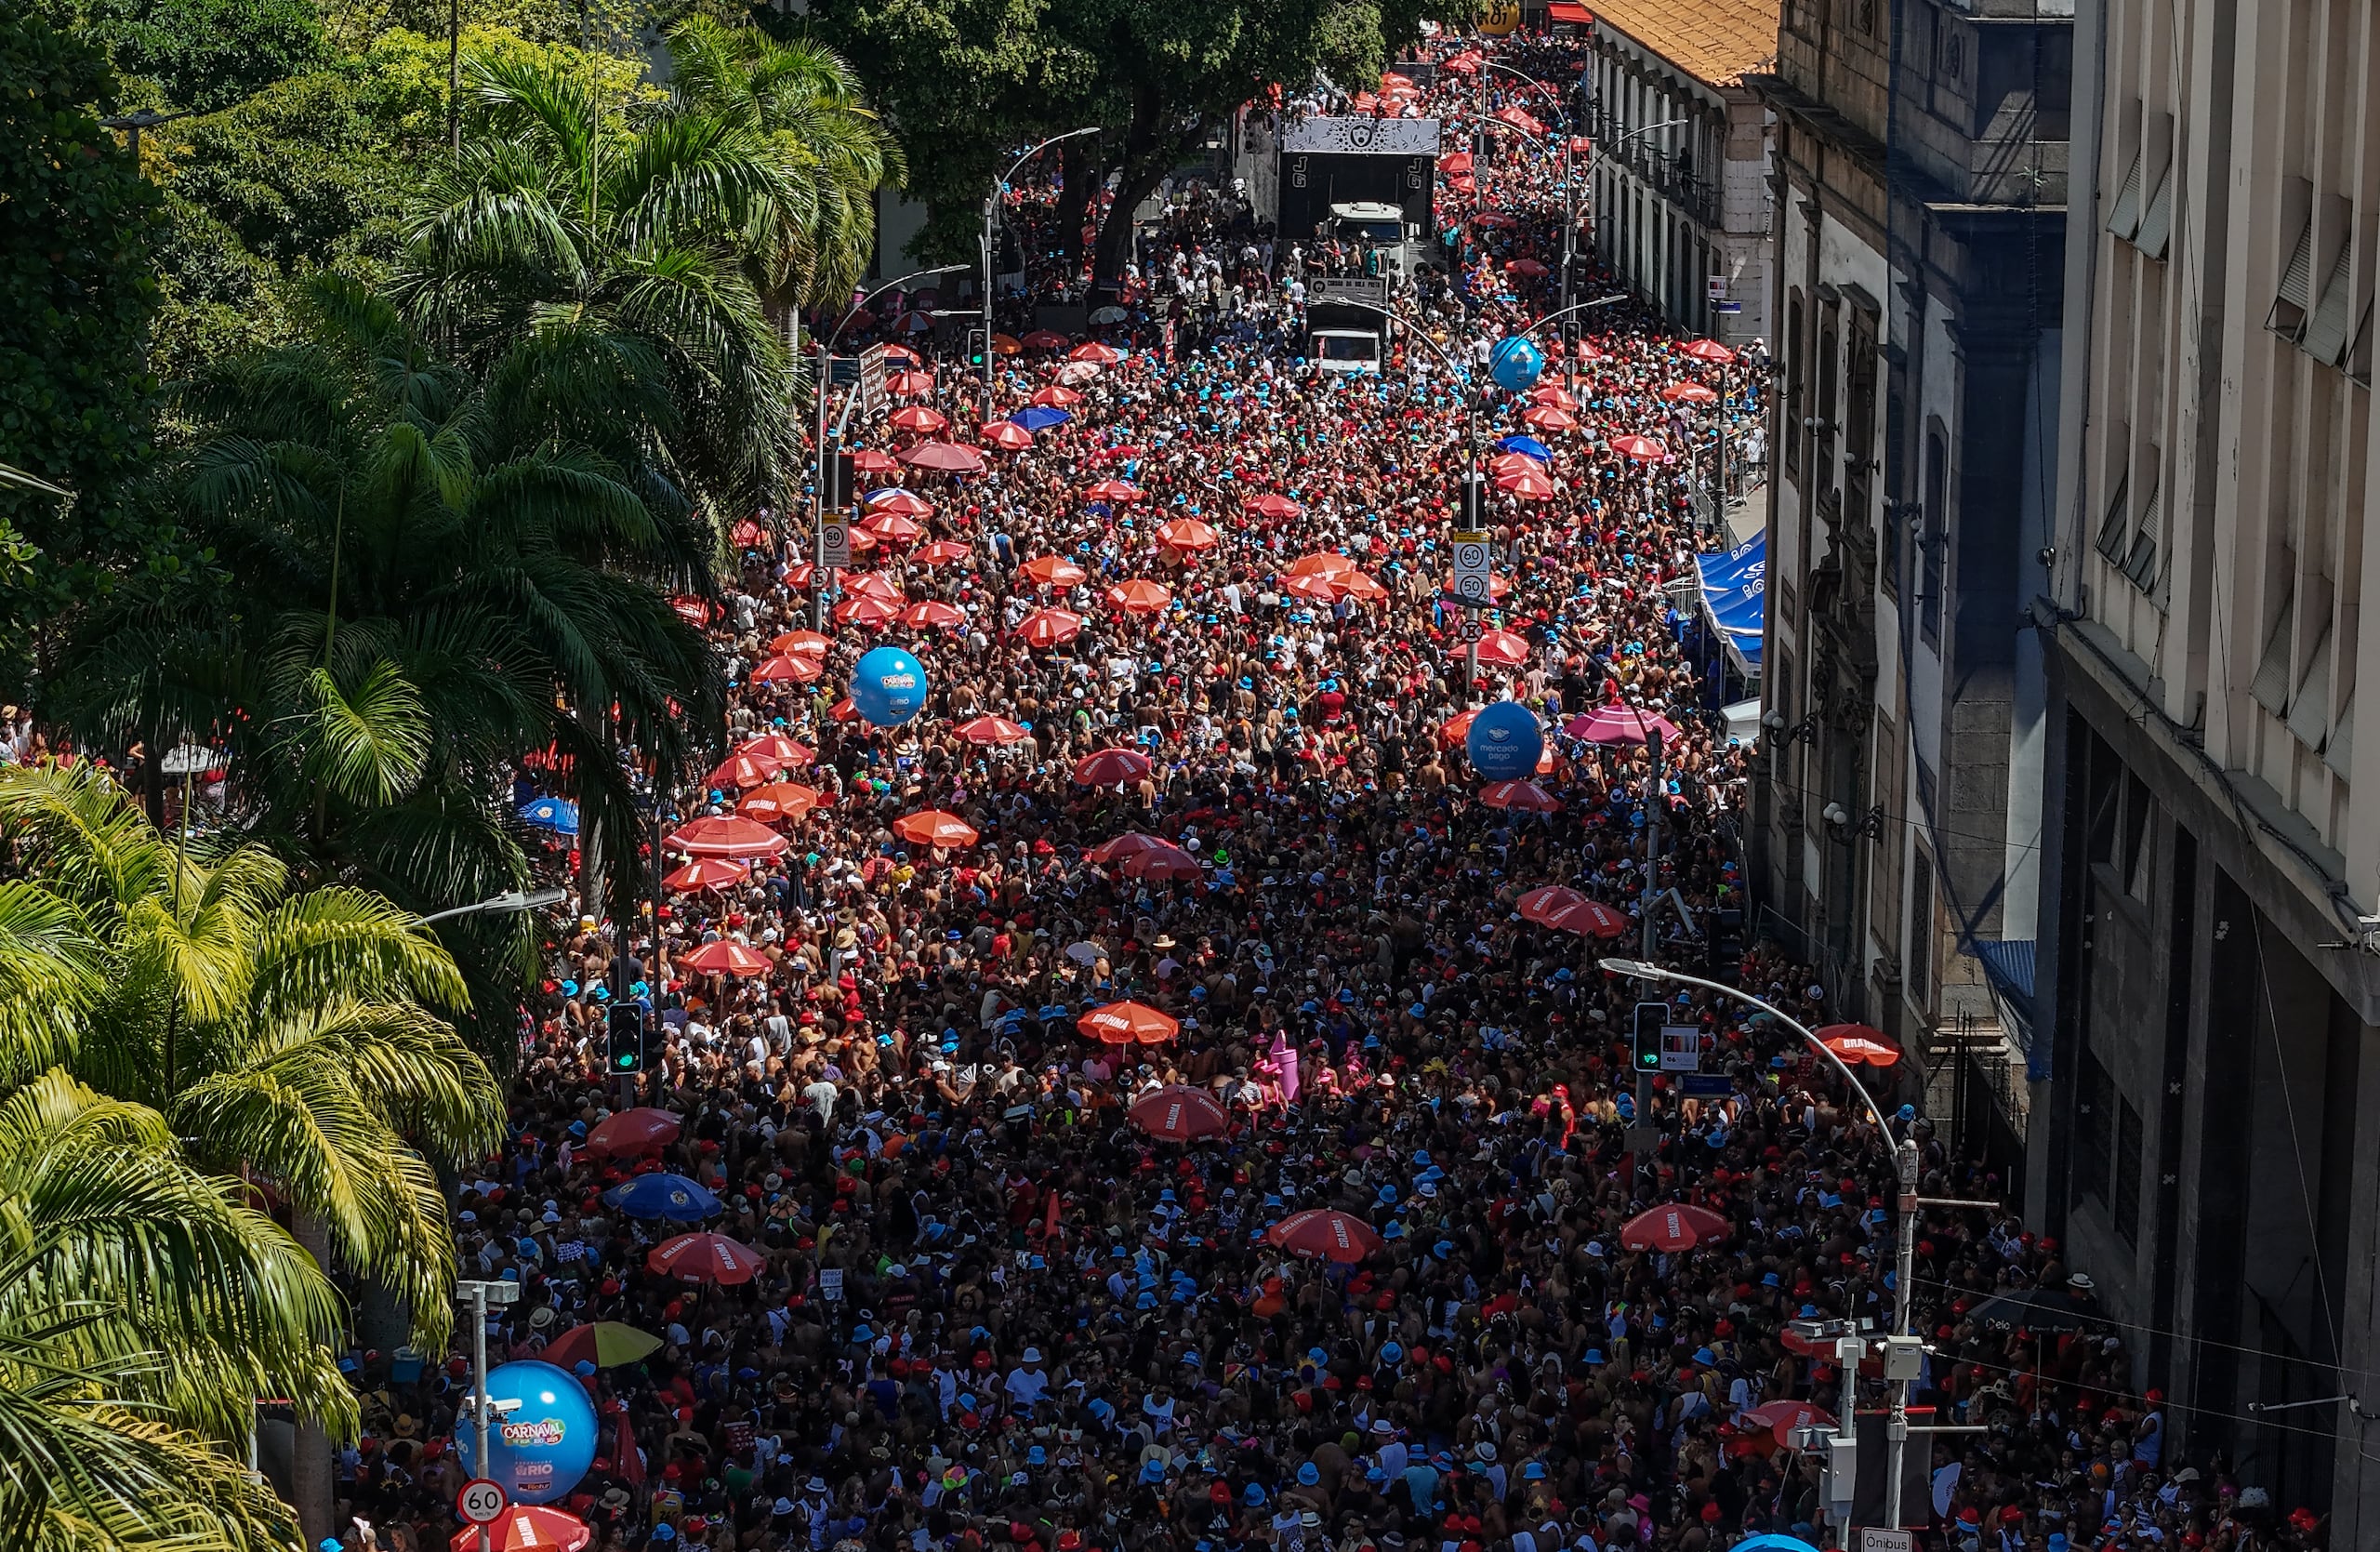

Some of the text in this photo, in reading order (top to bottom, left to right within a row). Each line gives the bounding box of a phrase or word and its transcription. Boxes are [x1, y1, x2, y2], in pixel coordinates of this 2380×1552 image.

[826, 532, 840, 541] 60
[1463, 550, 1479, 561] 60
[1464, 580, 1480, 591] 50
[793, 641, 826, 651] BRAHMA
[1480, 744, 1519, 752] mercado
[1488, 752, 1511, 761] pago
[745, 799, 777, 811] BRAHMA
[1533, 891, 1554, 912] BRAHMA
[1091, 1013, 1130, 1031] BRAHMA
[1843, 1038, 1886, 1053] BRAHMA
[1165, 1103, 1182, 1130] BRAHMA
[1279, 1213, 1314, 1235] BRAHMA
[1667, 1212, 1681, 1239] BRAHMA
[1331, 1218, 1350, 1249] BRAHMA
[661, 1237, 695, 1260] BRAHMA
[714, 1242, 737, 1271] BRAHMA
[504, 1422, 563, 1439] CARNAVAL
[528, 1464, 553, 1476] RIO
[468, 1491, 498, 1510] 60
[515, 1516, 538, 1546] BRAHMA
[1866, 1532, 1908, 1550] Ônibus
